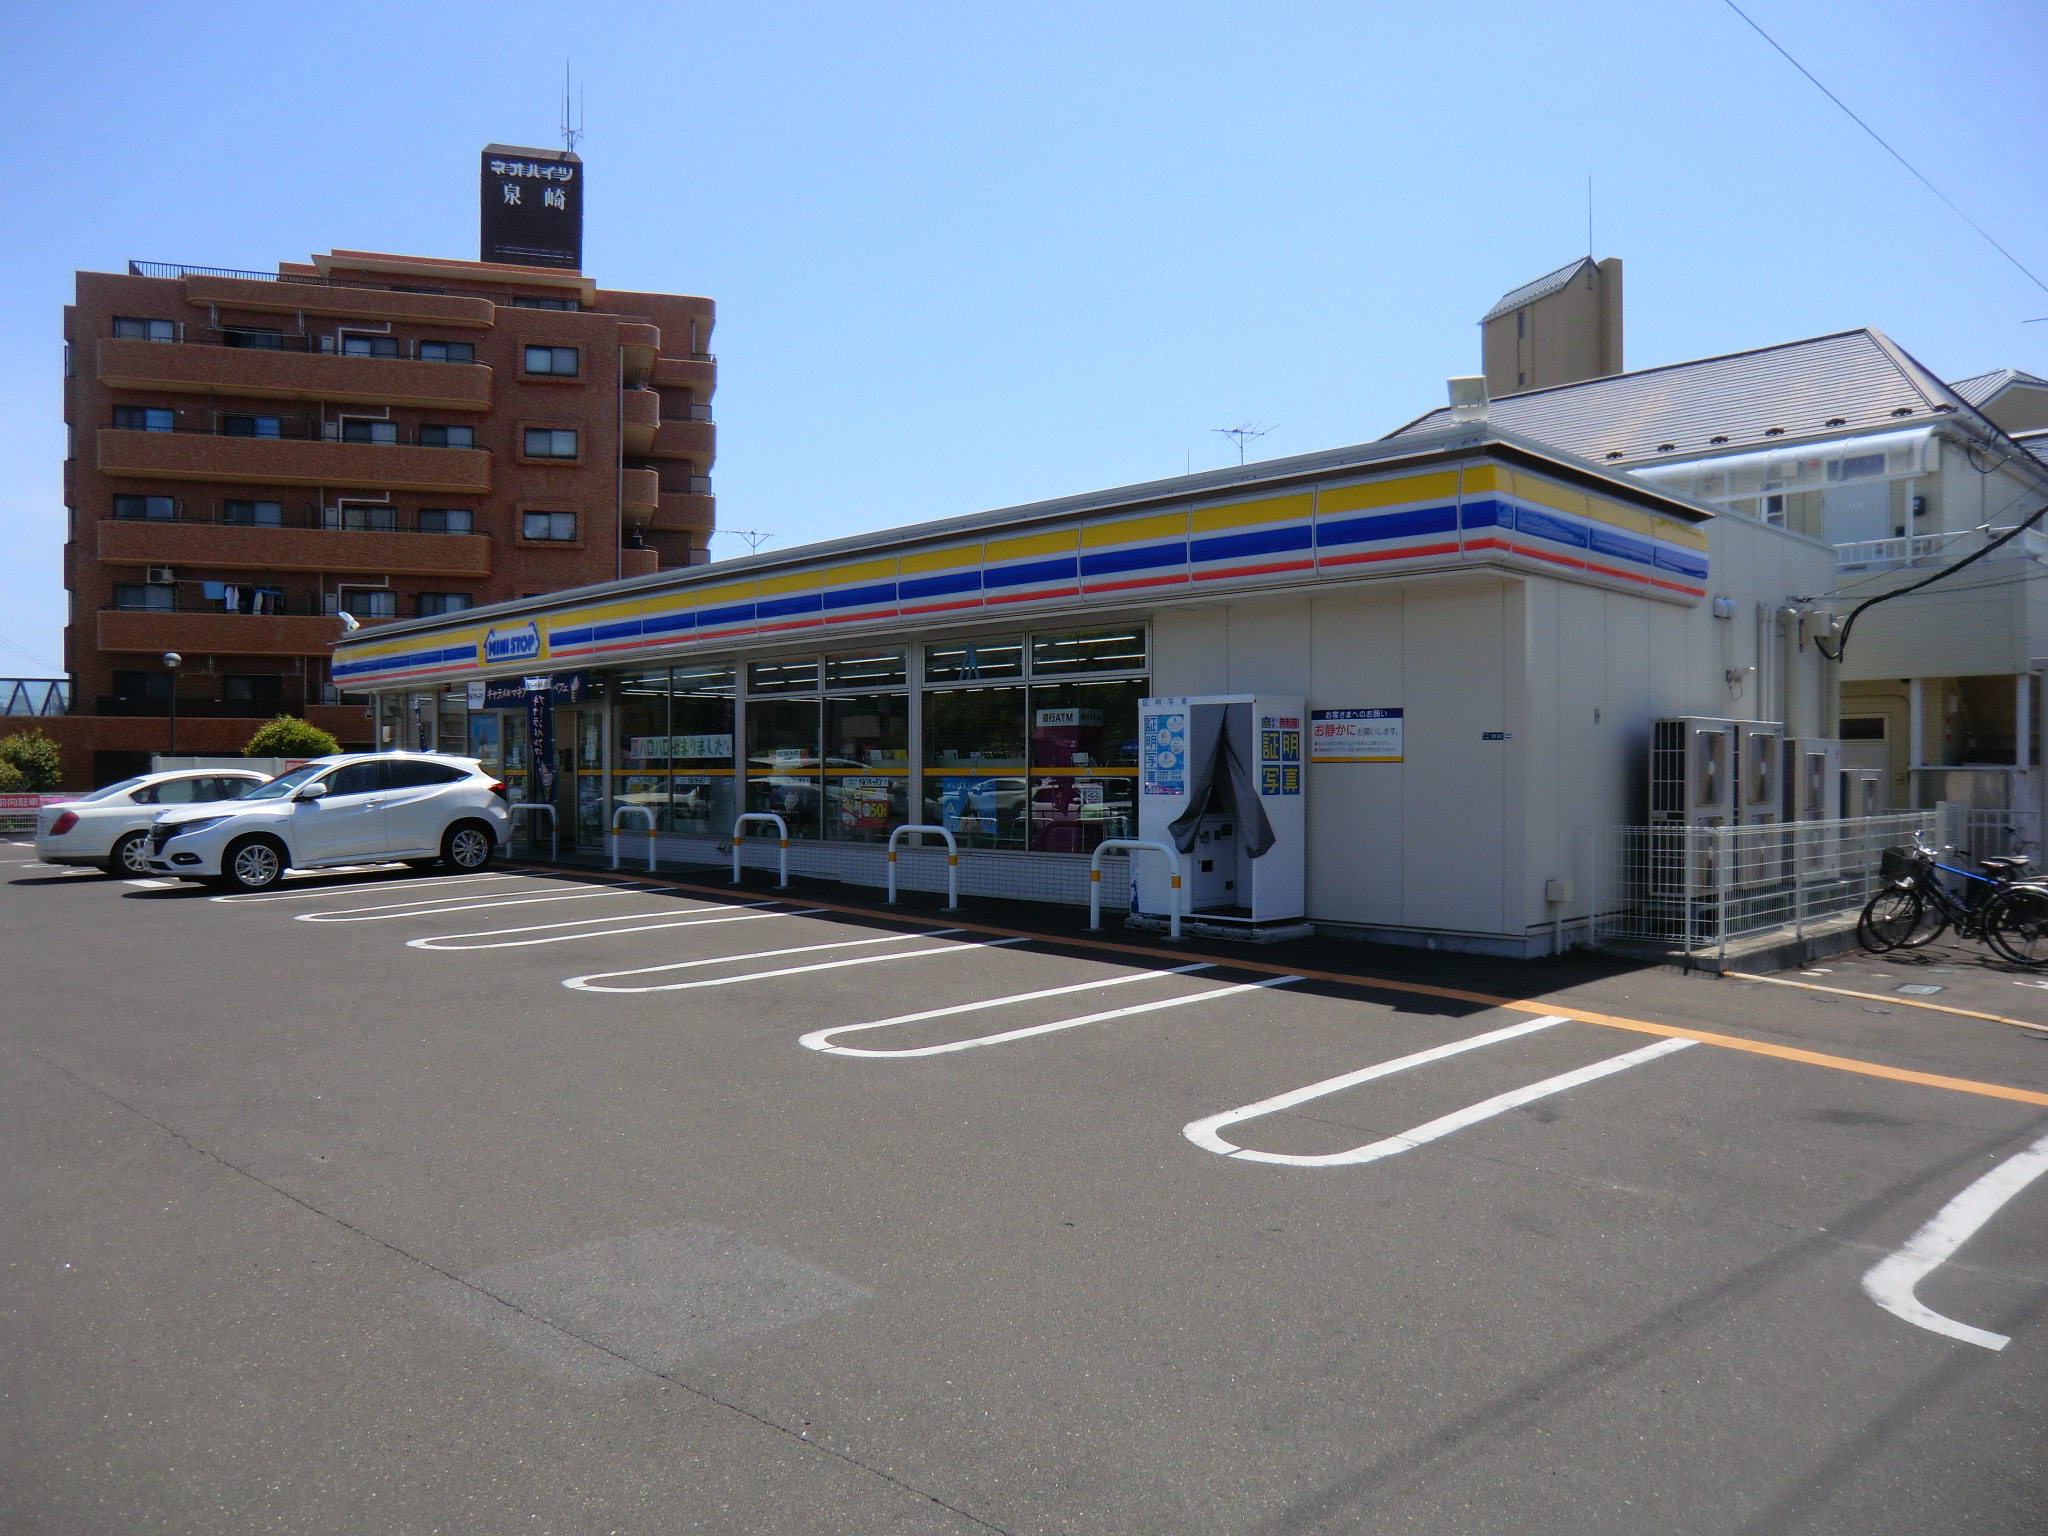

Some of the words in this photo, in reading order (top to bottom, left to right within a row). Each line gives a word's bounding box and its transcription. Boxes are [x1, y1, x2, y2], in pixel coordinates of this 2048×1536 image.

[488, 638, 509, 657] MINI
[510, 634, 535, 654] STOP
[1325, 710, 1388, 719] お客さまへのお願い
[1314, 724, 1356, 738] お静かに
[1263, 732, 1299, 760] 証明
[1263, 767, 1299, 794] 写真
